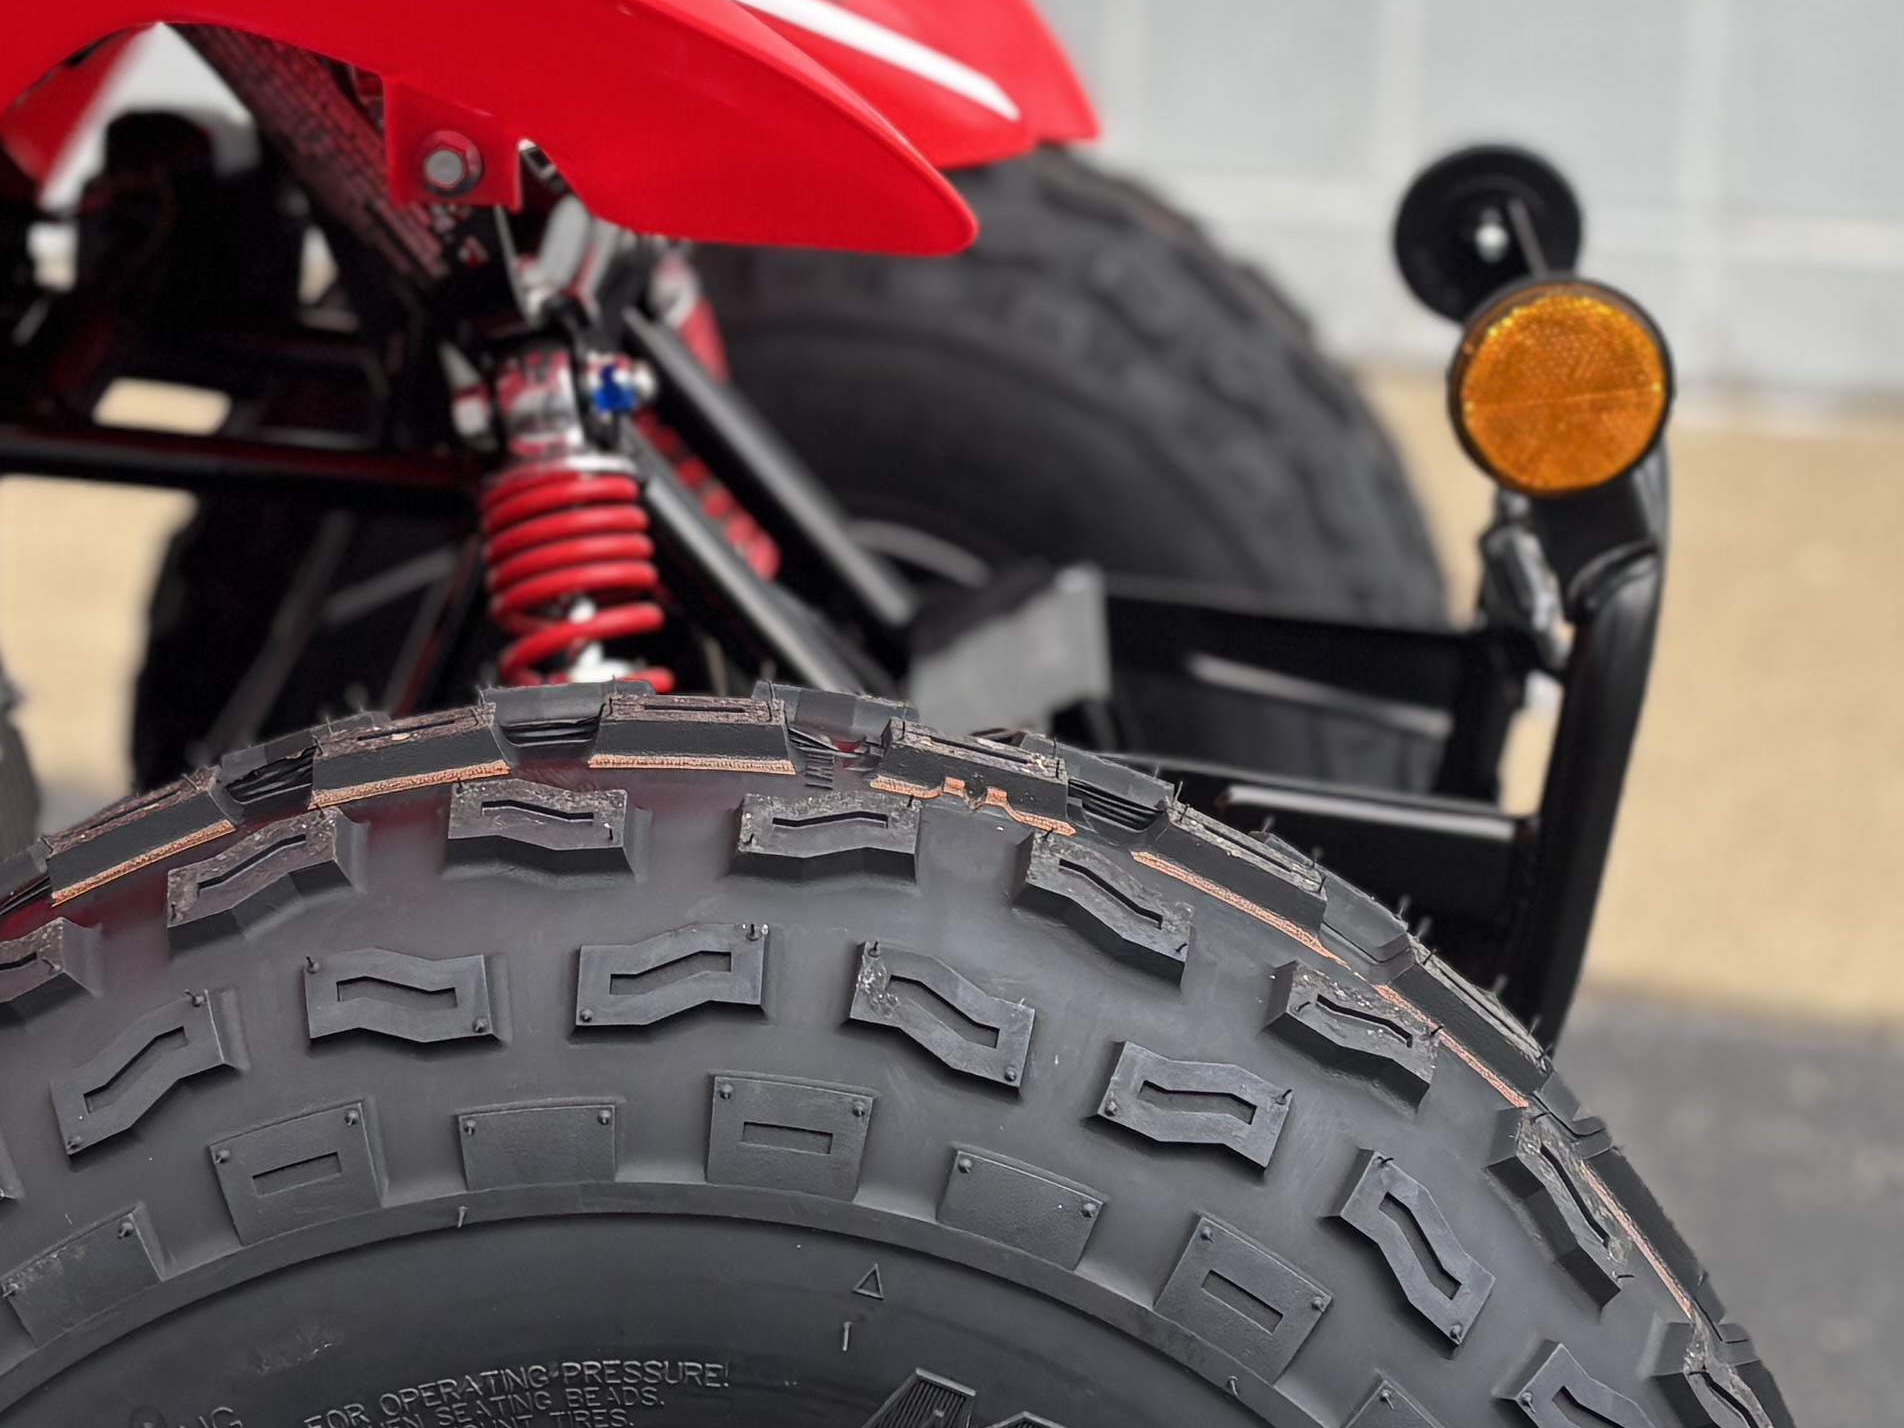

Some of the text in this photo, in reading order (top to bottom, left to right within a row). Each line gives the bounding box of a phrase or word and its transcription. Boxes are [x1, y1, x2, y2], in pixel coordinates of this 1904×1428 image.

[378, 1365, 548, 1415] OPERATING
[435, 1392, 552, 1426] SEATING
[564, 1386, 664, 1407] BEADS.
